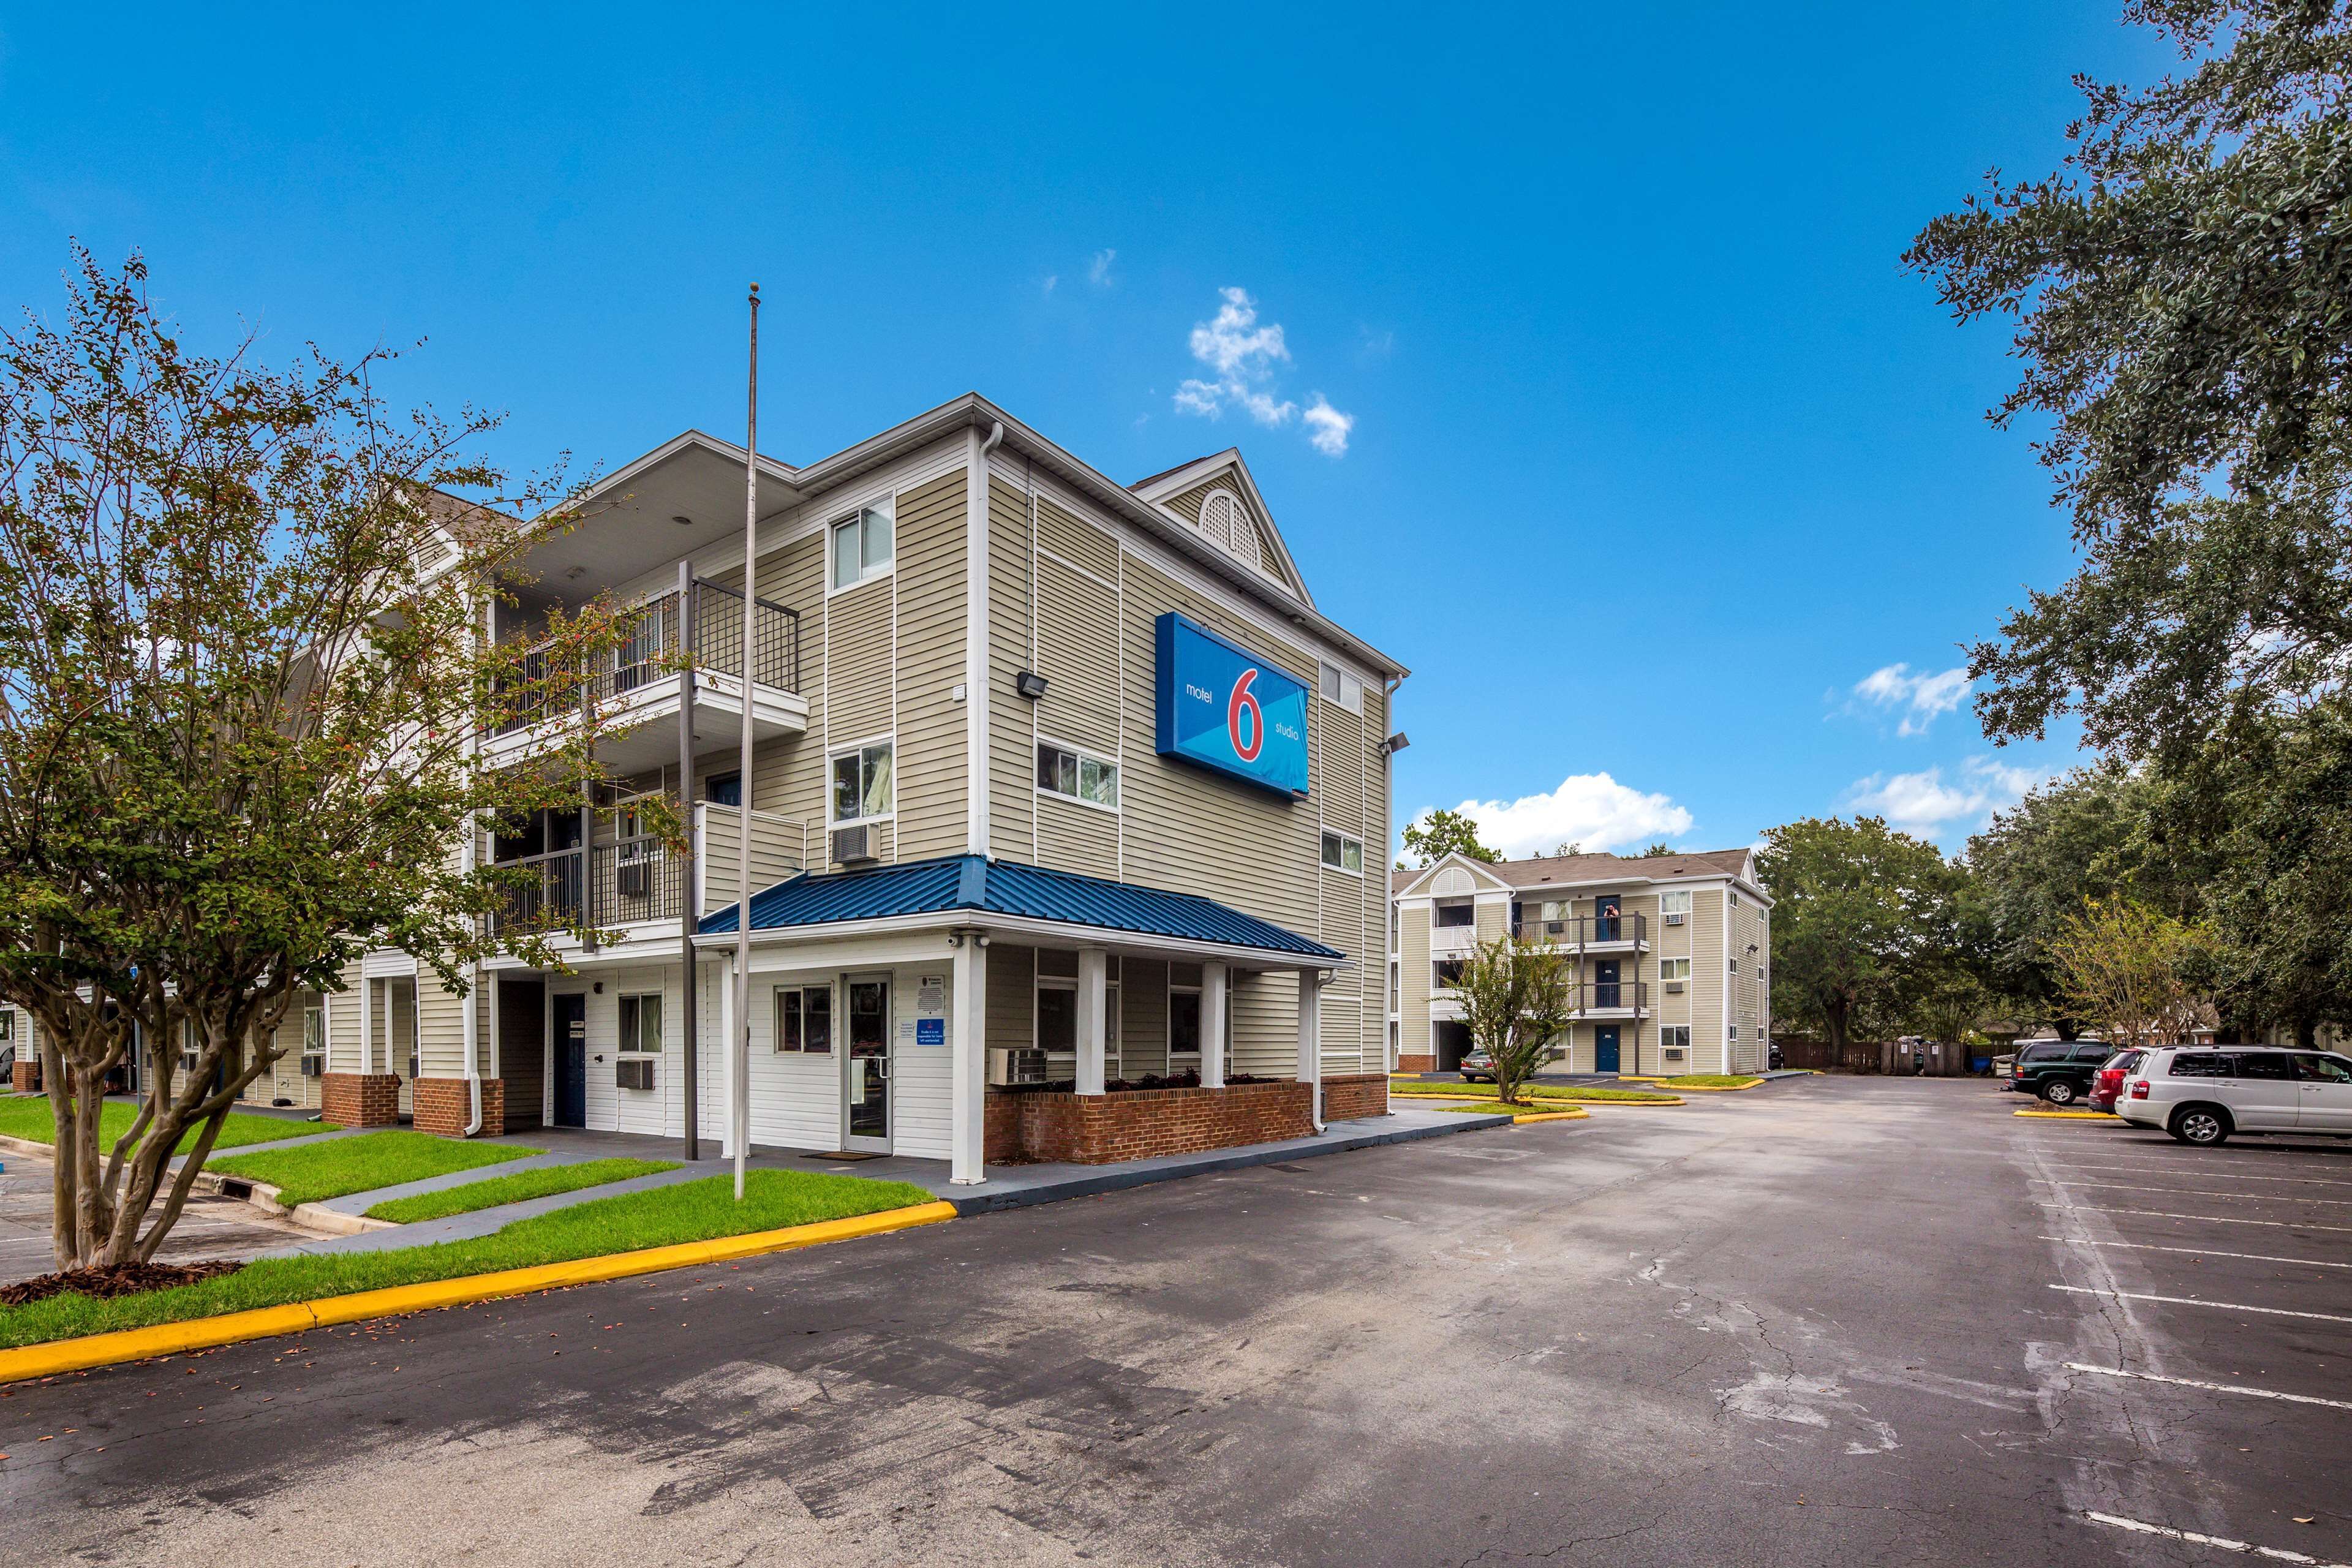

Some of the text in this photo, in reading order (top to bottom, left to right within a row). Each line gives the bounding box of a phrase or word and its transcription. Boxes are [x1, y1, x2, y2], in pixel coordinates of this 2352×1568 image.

[1186, 668, 1299, 763] motel 6 studio
